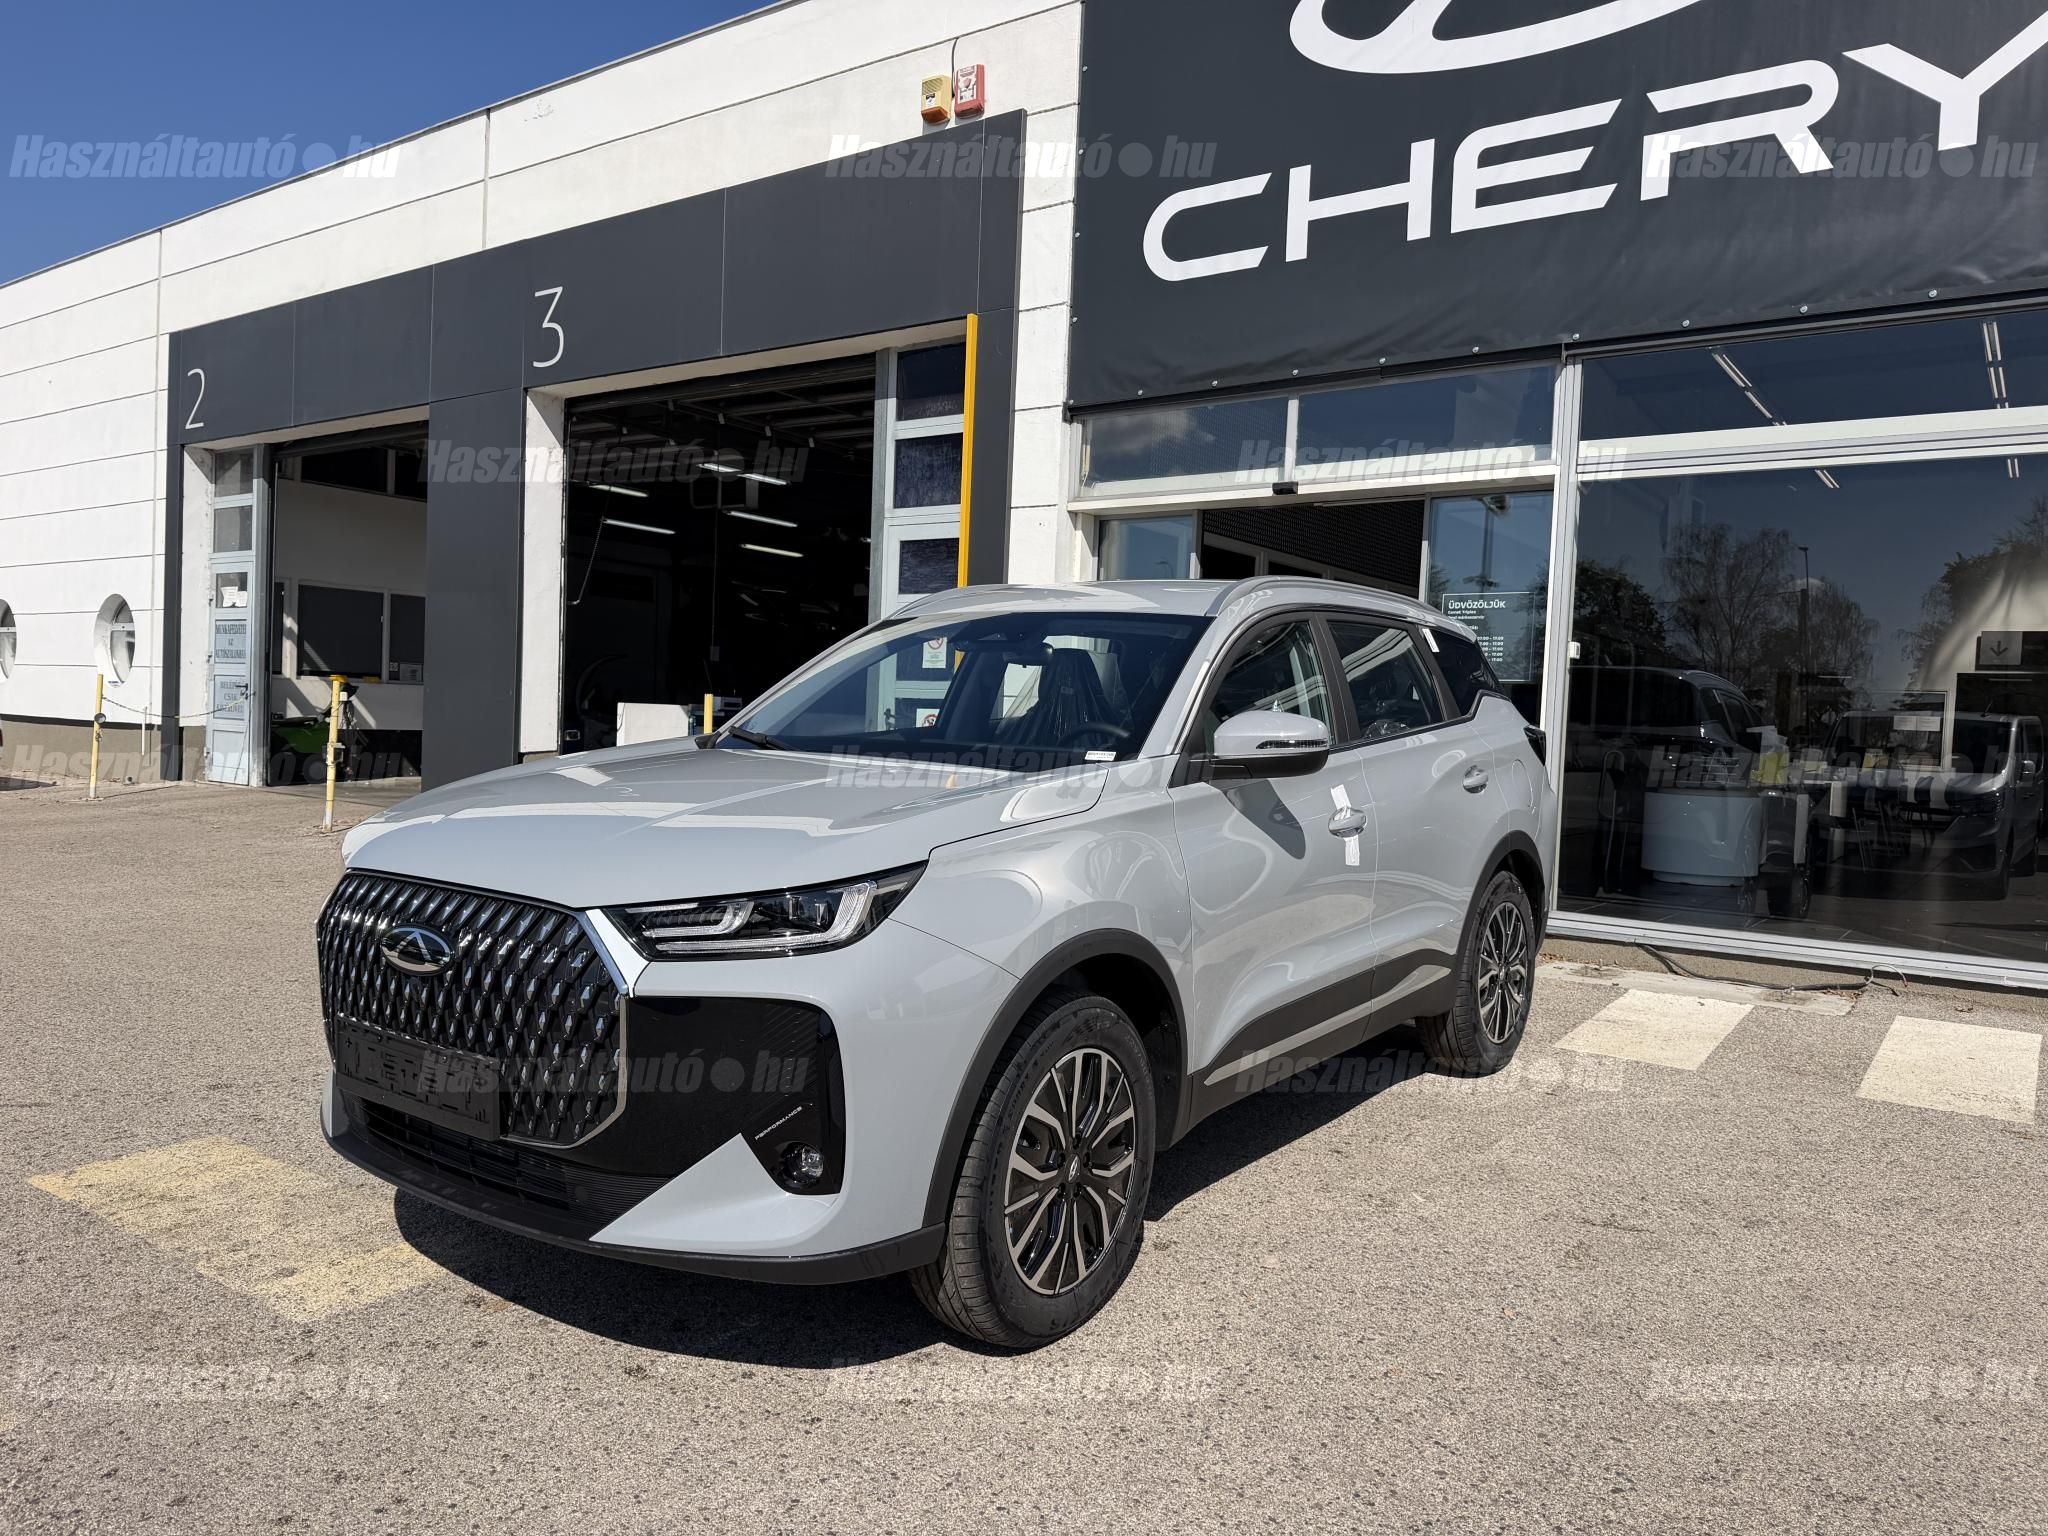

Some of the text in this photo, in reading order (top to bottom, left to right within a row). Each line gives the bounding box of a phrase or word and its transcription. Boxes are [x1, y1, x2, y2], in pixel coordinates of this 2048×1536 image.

[1143, 11, 2048, 281] CHERY
[533, 286, 564, 368] 3
[185, 368, 205, 430] 2
[1448, 599, 1506, 609] ÜDVÖZÖLJÜK
